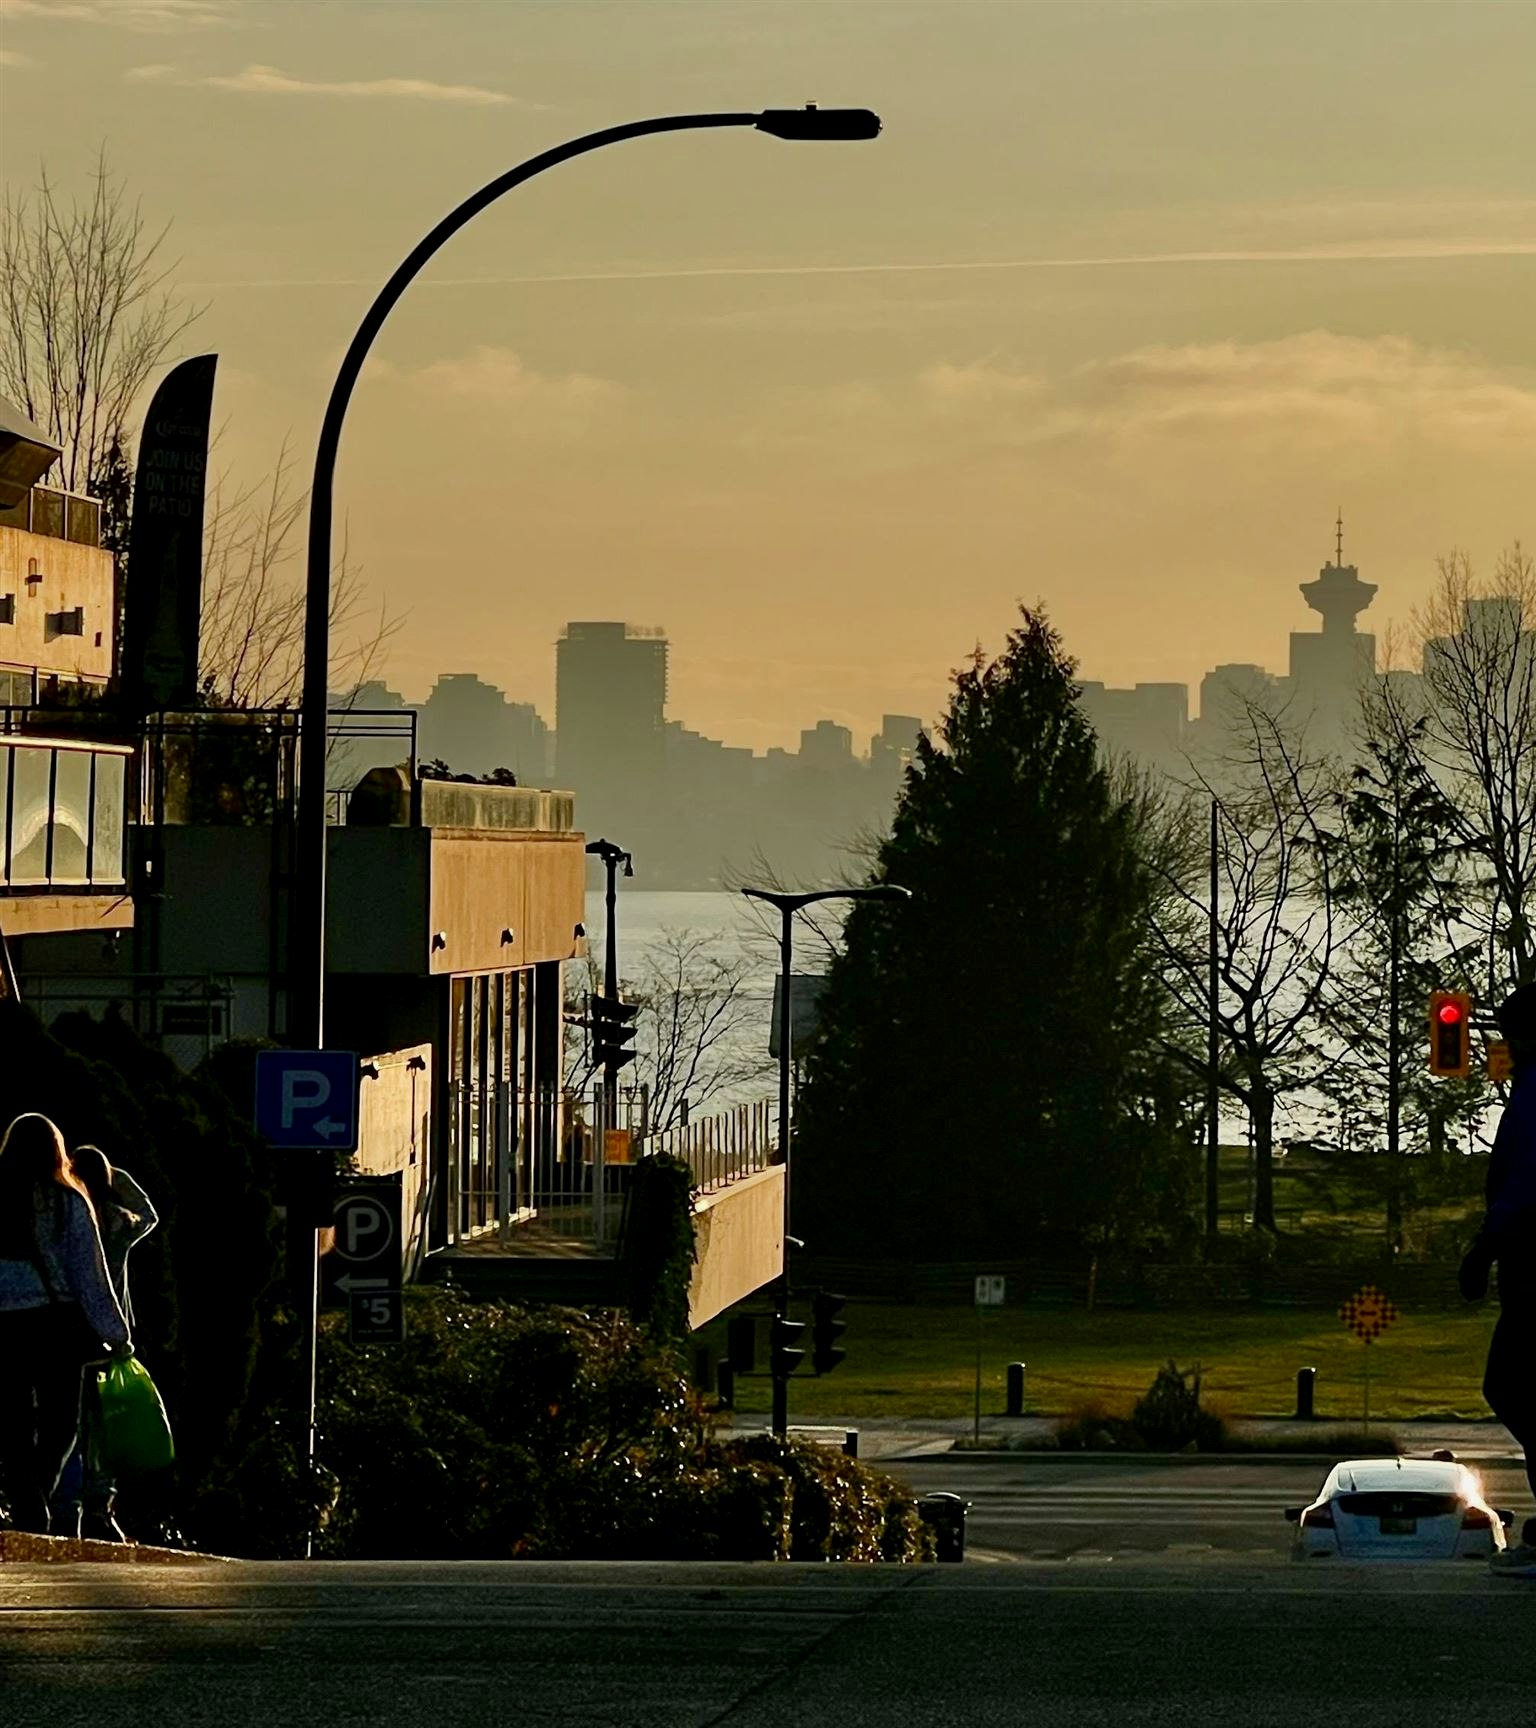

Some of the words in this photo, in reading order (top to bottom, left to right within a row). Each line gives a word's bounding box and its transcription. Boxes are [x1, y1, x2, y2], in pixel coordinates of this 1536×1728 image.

[145, 448, 181, 470] JOIN
[183, 450, 205, 473] US
[145, 471, 166, 493] ON
[169, 474, 201, 496] THE
[148, 495, 193, 518] PATIO
[281, 1069, 332, 1129] P
[346, 1206, 381, 1254] P
